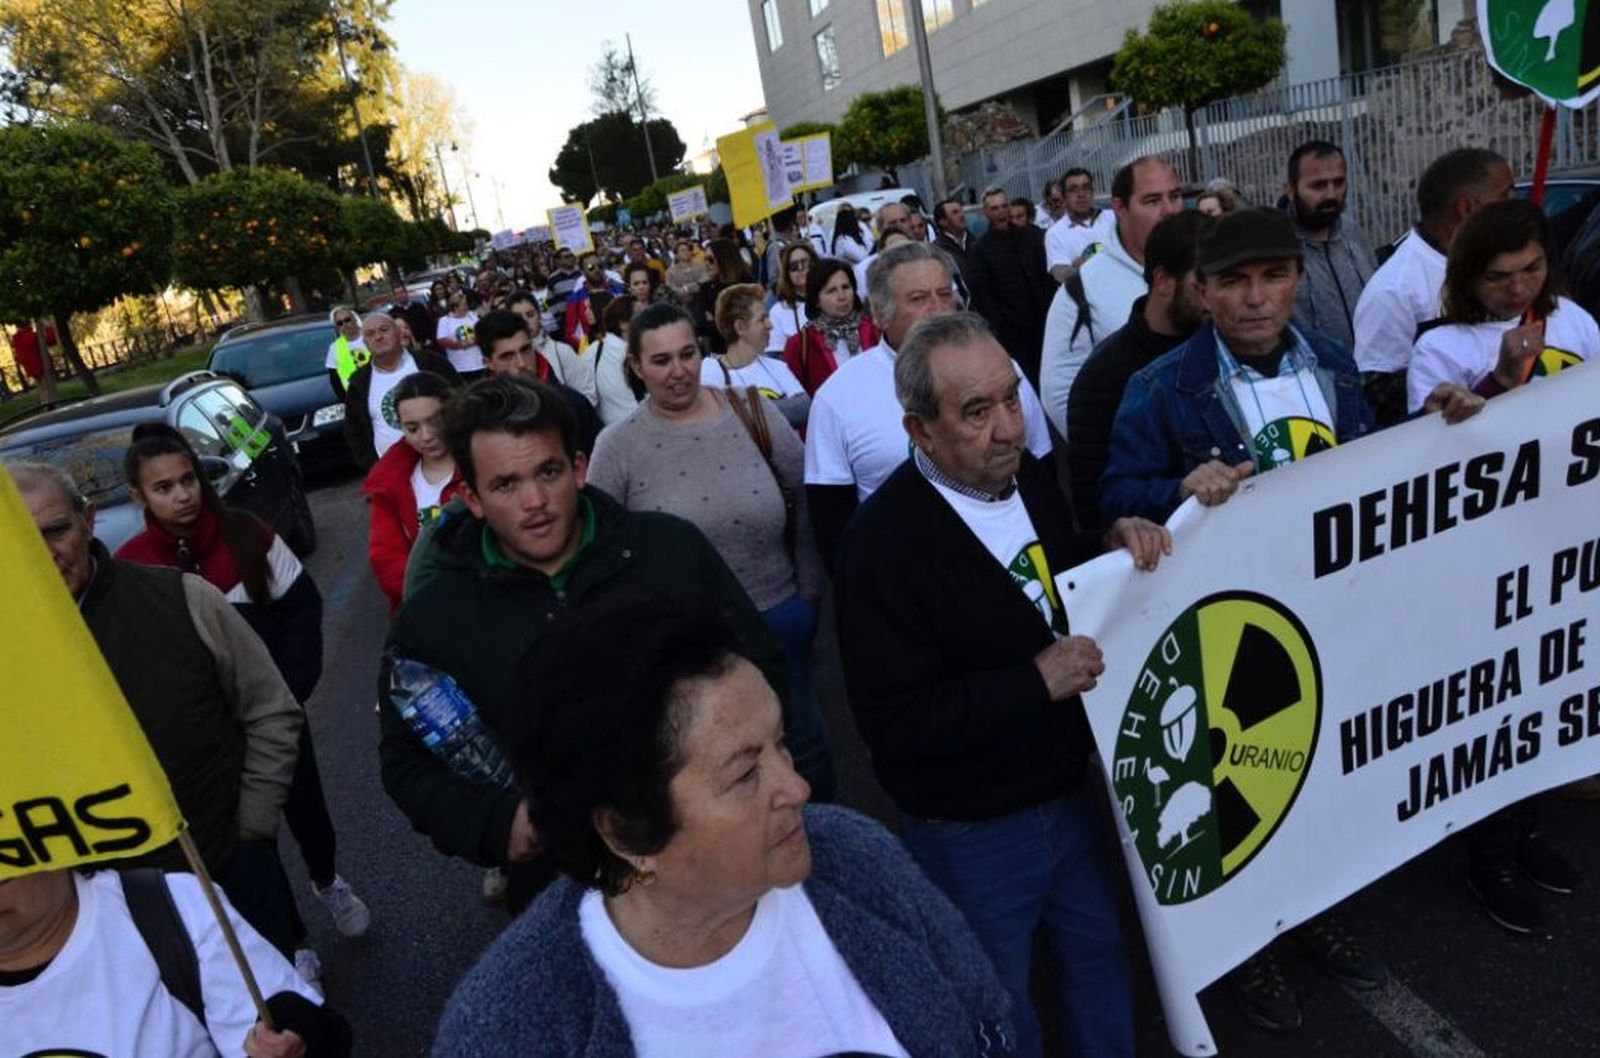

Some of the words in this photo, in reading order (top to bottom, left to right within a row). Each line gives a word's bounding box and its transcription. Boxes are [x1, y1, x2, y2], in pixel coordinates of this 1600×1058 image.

[1313, 439, 1540, 579] DEHESA
[1495, 563, 1533, 630] EL
[1340, 647, 1521, 776] HIGUERA
[1539, 618, 1587, 685] DE
[1230, 744, 1305, 773] URANIO
[1397, 711, 1542, 822] JAMÁS
[1151, 863, 1201, 900] SIN
